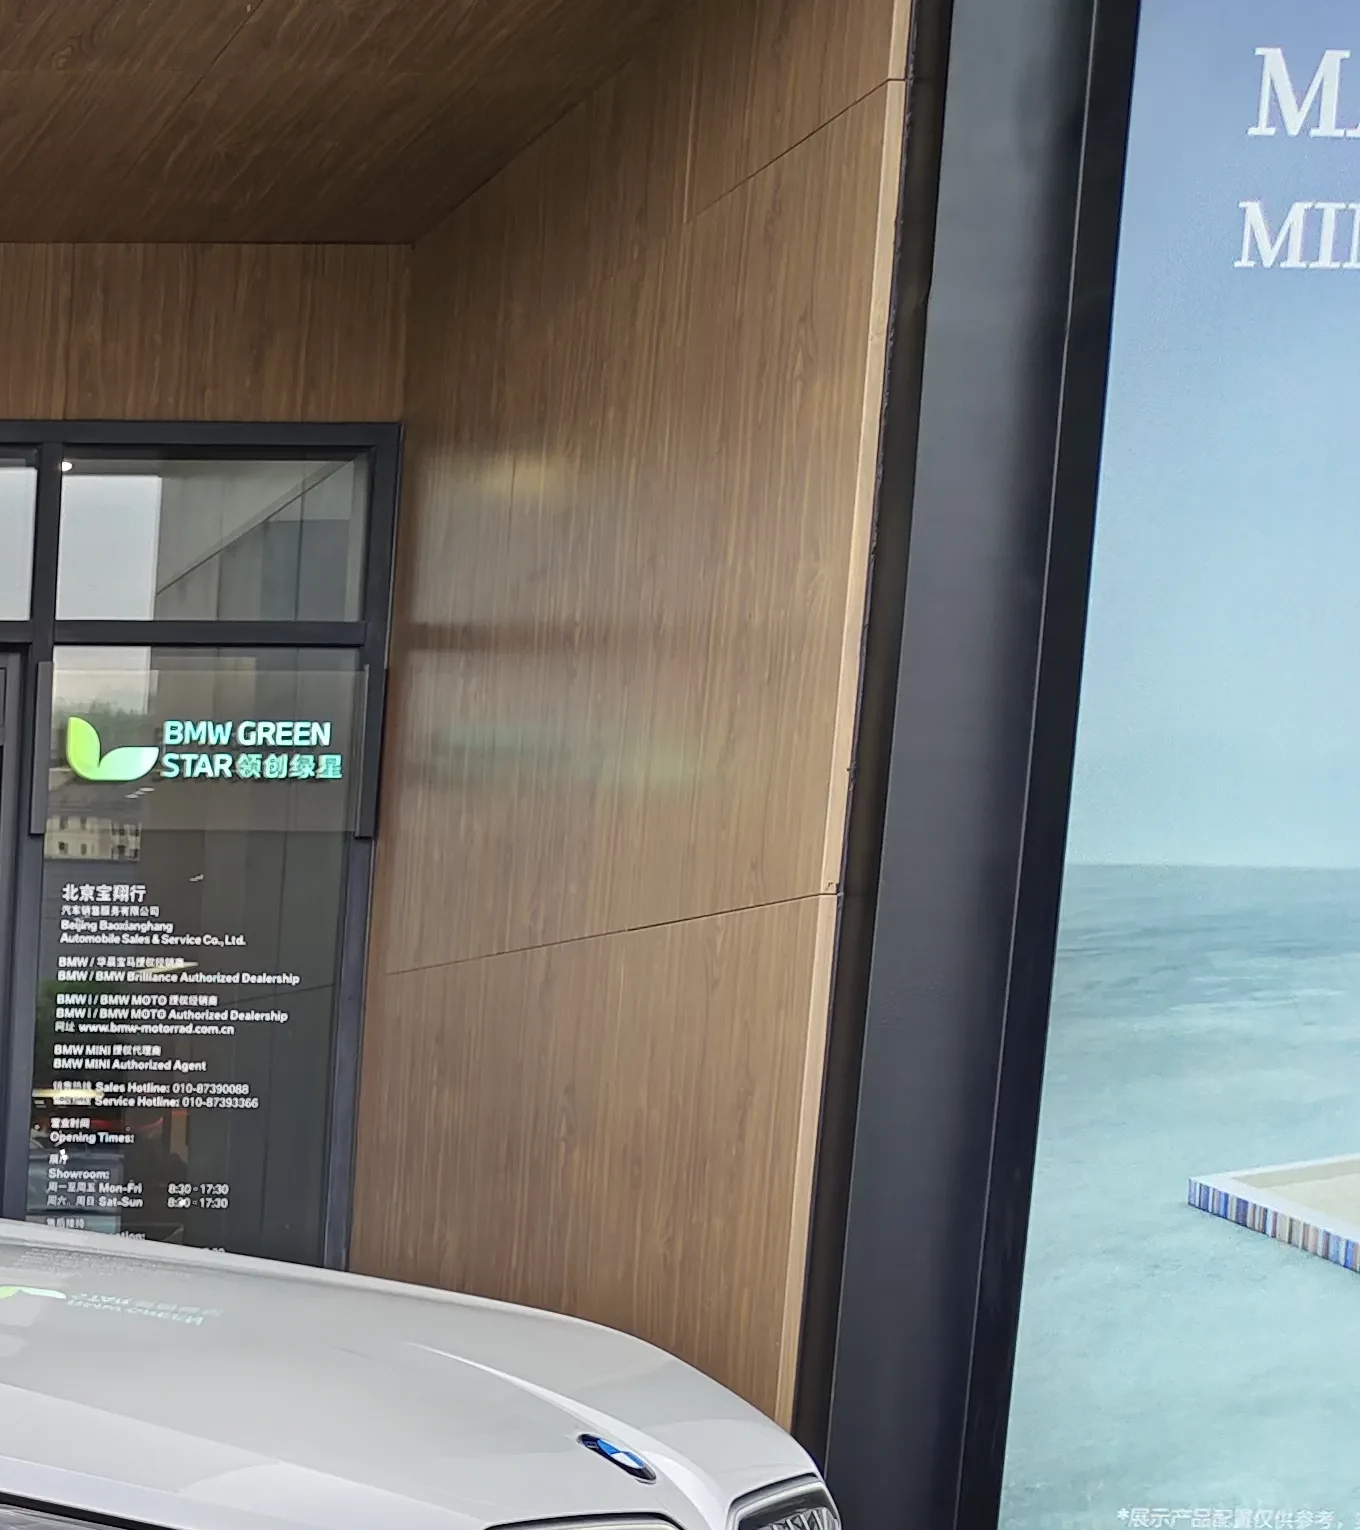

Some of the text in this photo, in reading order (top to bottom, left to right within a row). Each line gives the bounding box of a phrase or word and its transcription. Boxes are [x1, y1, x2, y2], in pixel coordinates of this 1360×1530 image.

[1246, 46, 1360, 138] M
[1233, 200, 1360, 269] MI
[163, 720, 331, 746] BMW GREEN
[160, 753, 343, 780] STAR 领创绿星
[62, 884, 146, 902] 北京宝翔行
[60, 919, 173, 933] Beijing Baoxianghang
[60, 933, 121, 945] Automobile
[121, 935, 150, 945] Sales
[152, 935, 160, 945] &
[161, 935, 201, 946] Service
[58, 957, 88, 968] BMW
[57, 970, 87, 981] BMW
[95, 970, 125, 981] BMW
[126, 971, 178, 983] Brilliance
[180, 972, 240, 983] Authorized
[242, 973, 300, 986] Dealership
[56, 993, 86, 1005] BMW
[100, 994, 130, 1005] BMW
[130, 995, 167, 1006] MOTO
[55, 1007, 85, 1019] BMW
[99, 1008, 129, 1019] BMW
[130, 1008, 167, 1020] MOTO
[168, 1009, 228, 1020] Authorized
[229, 1010, 288, 1023] Dealership
[78, 1021, 235, 1035] www.bmw-motorrad.com.cn
[53, 1044, 84, 1056] BMW
[85, 1044, 111, 1056] MINI
[53, 1058, 207, 1073] BMW MINI Authorized Agent
[95, 1081, 125, 1094] Sales
[127, 1081, 170, 1094] Hotline:
[172, 1082, 250, 1095] 010-87390088
[95, 1095, 135, 1108] Service
[137, 1096, 180, 1108] Hotline:
[182, 1097, 259, 1109] 010-87393366
[49, 1130, 135, 1145] Opening Times:
[48, 1167, 110, 1180] Showroom:
[98, 1181, 143, 1194] Mon-Fri
[167, 1183, 192, 1195] 8:30
[200, 1183, 230, 1195] 17:30
[98, 1195, 143, 1207] Sat-Sun
[199, 1197, 229, 1209] 17:30
